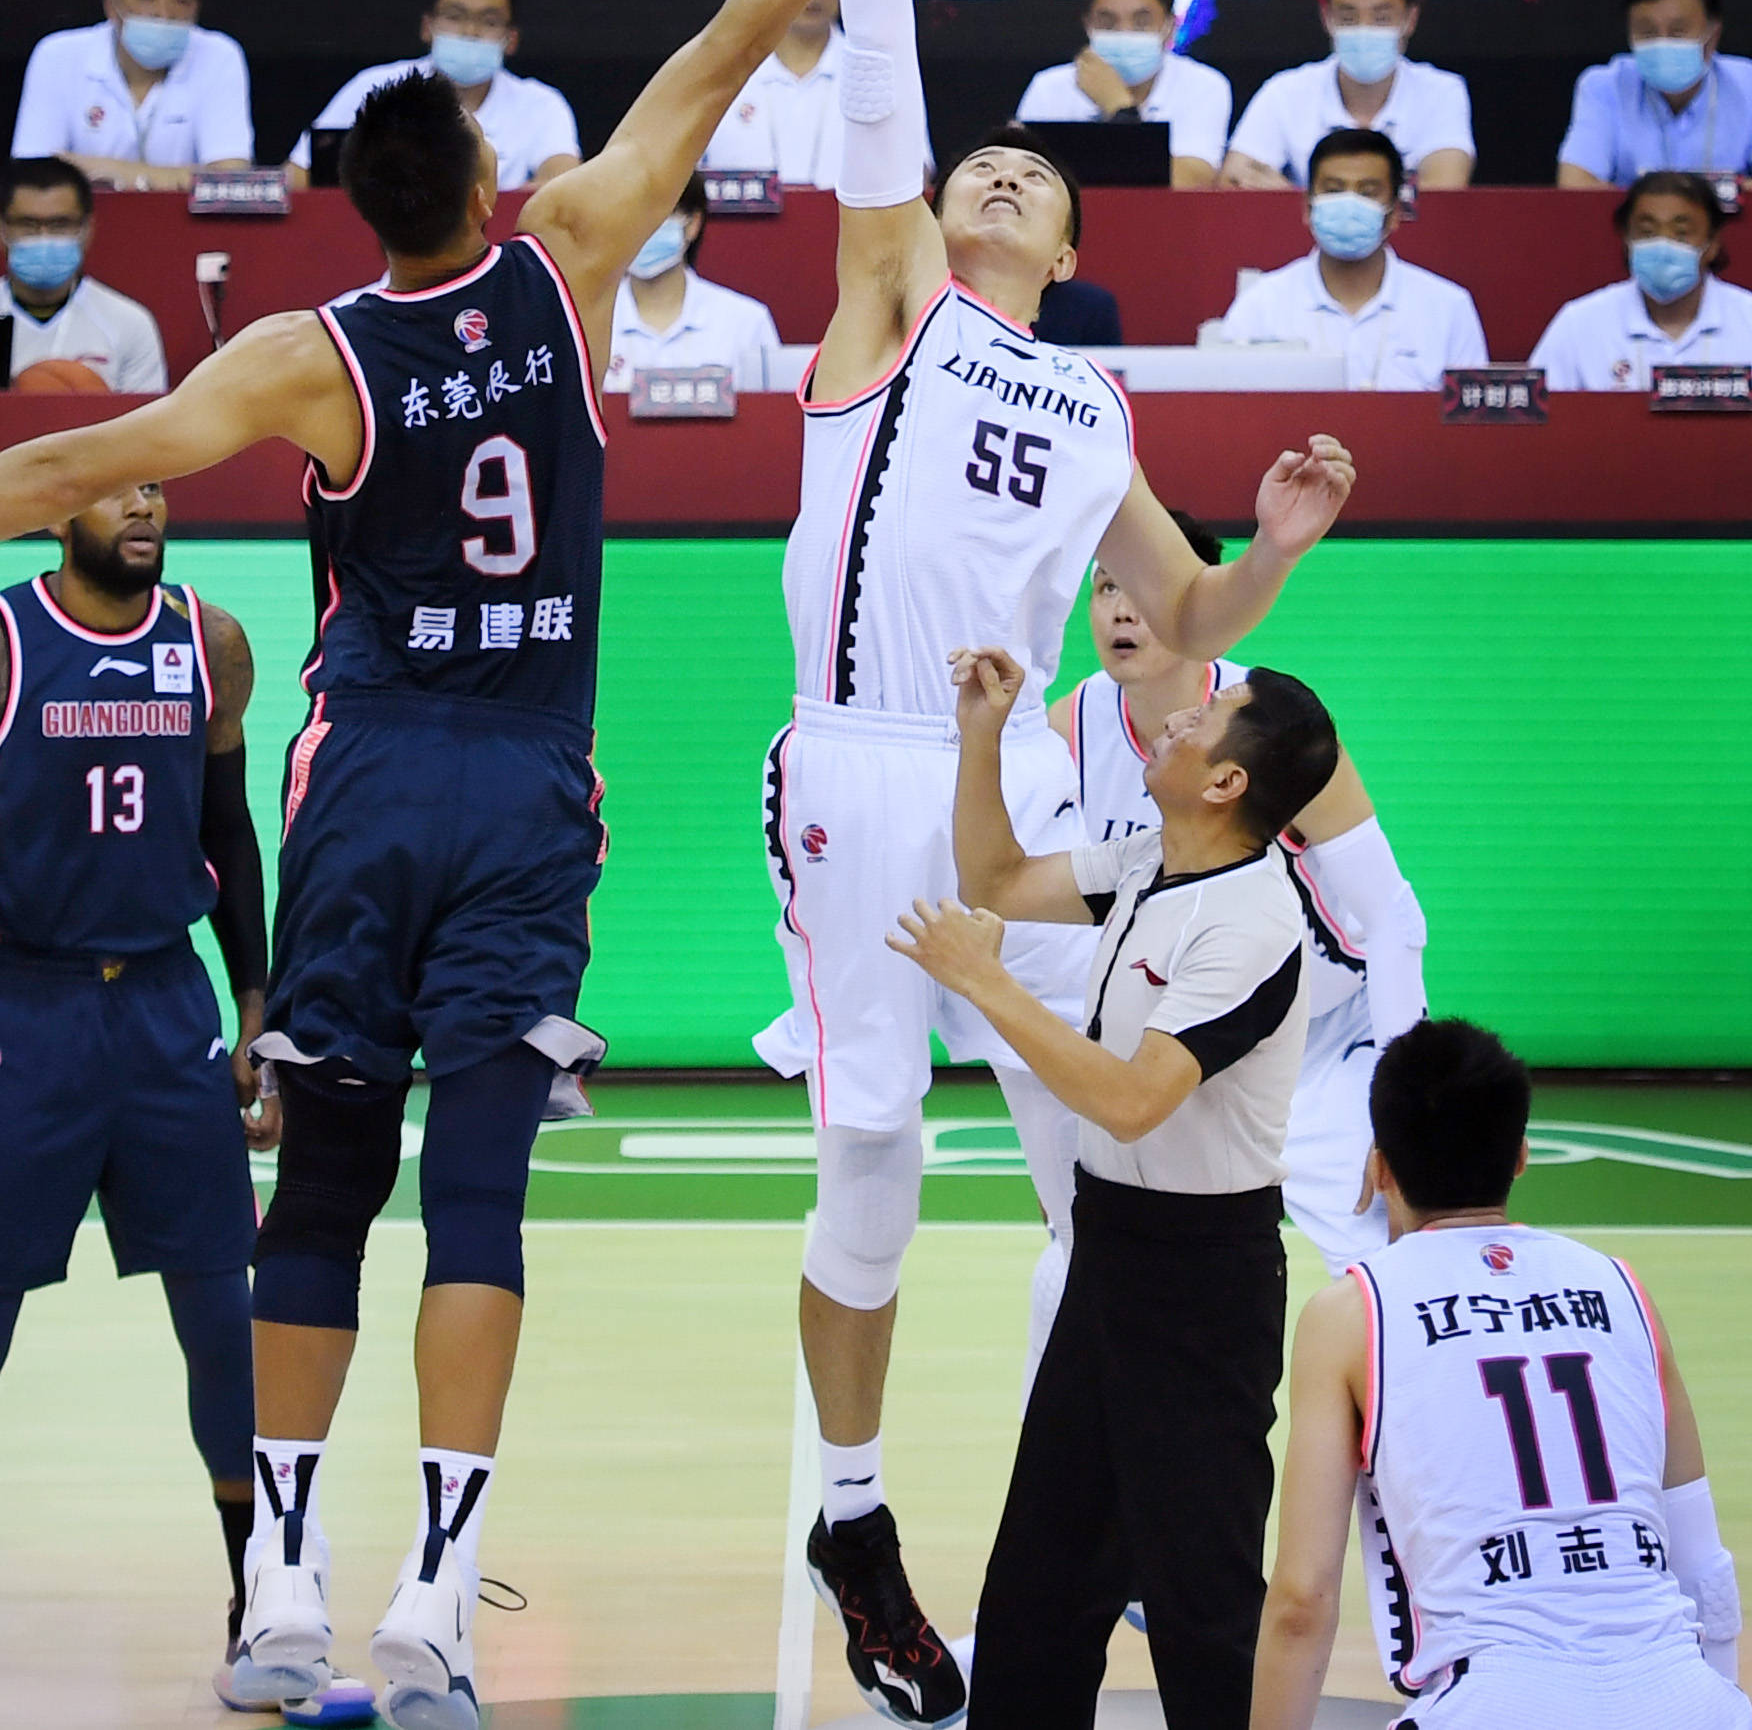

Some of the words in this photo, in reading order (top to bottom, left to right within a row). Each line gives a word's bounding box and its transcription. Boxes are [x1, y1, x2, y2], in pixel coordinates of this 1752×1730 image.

[936, 351, 1102, 430] LIAONING
[963, 417, 1053, 510] 55
[460, 432, 540, 577] 9
[406, 593, 575, 653] 易建联
[41, 700, 193, 738] GUANGDONG
[85, 763, 146, 835] 13
[1416, 1287, 1615, 1349] 辽宁本钢
[1476, 1350, 1619, 1511] 11
